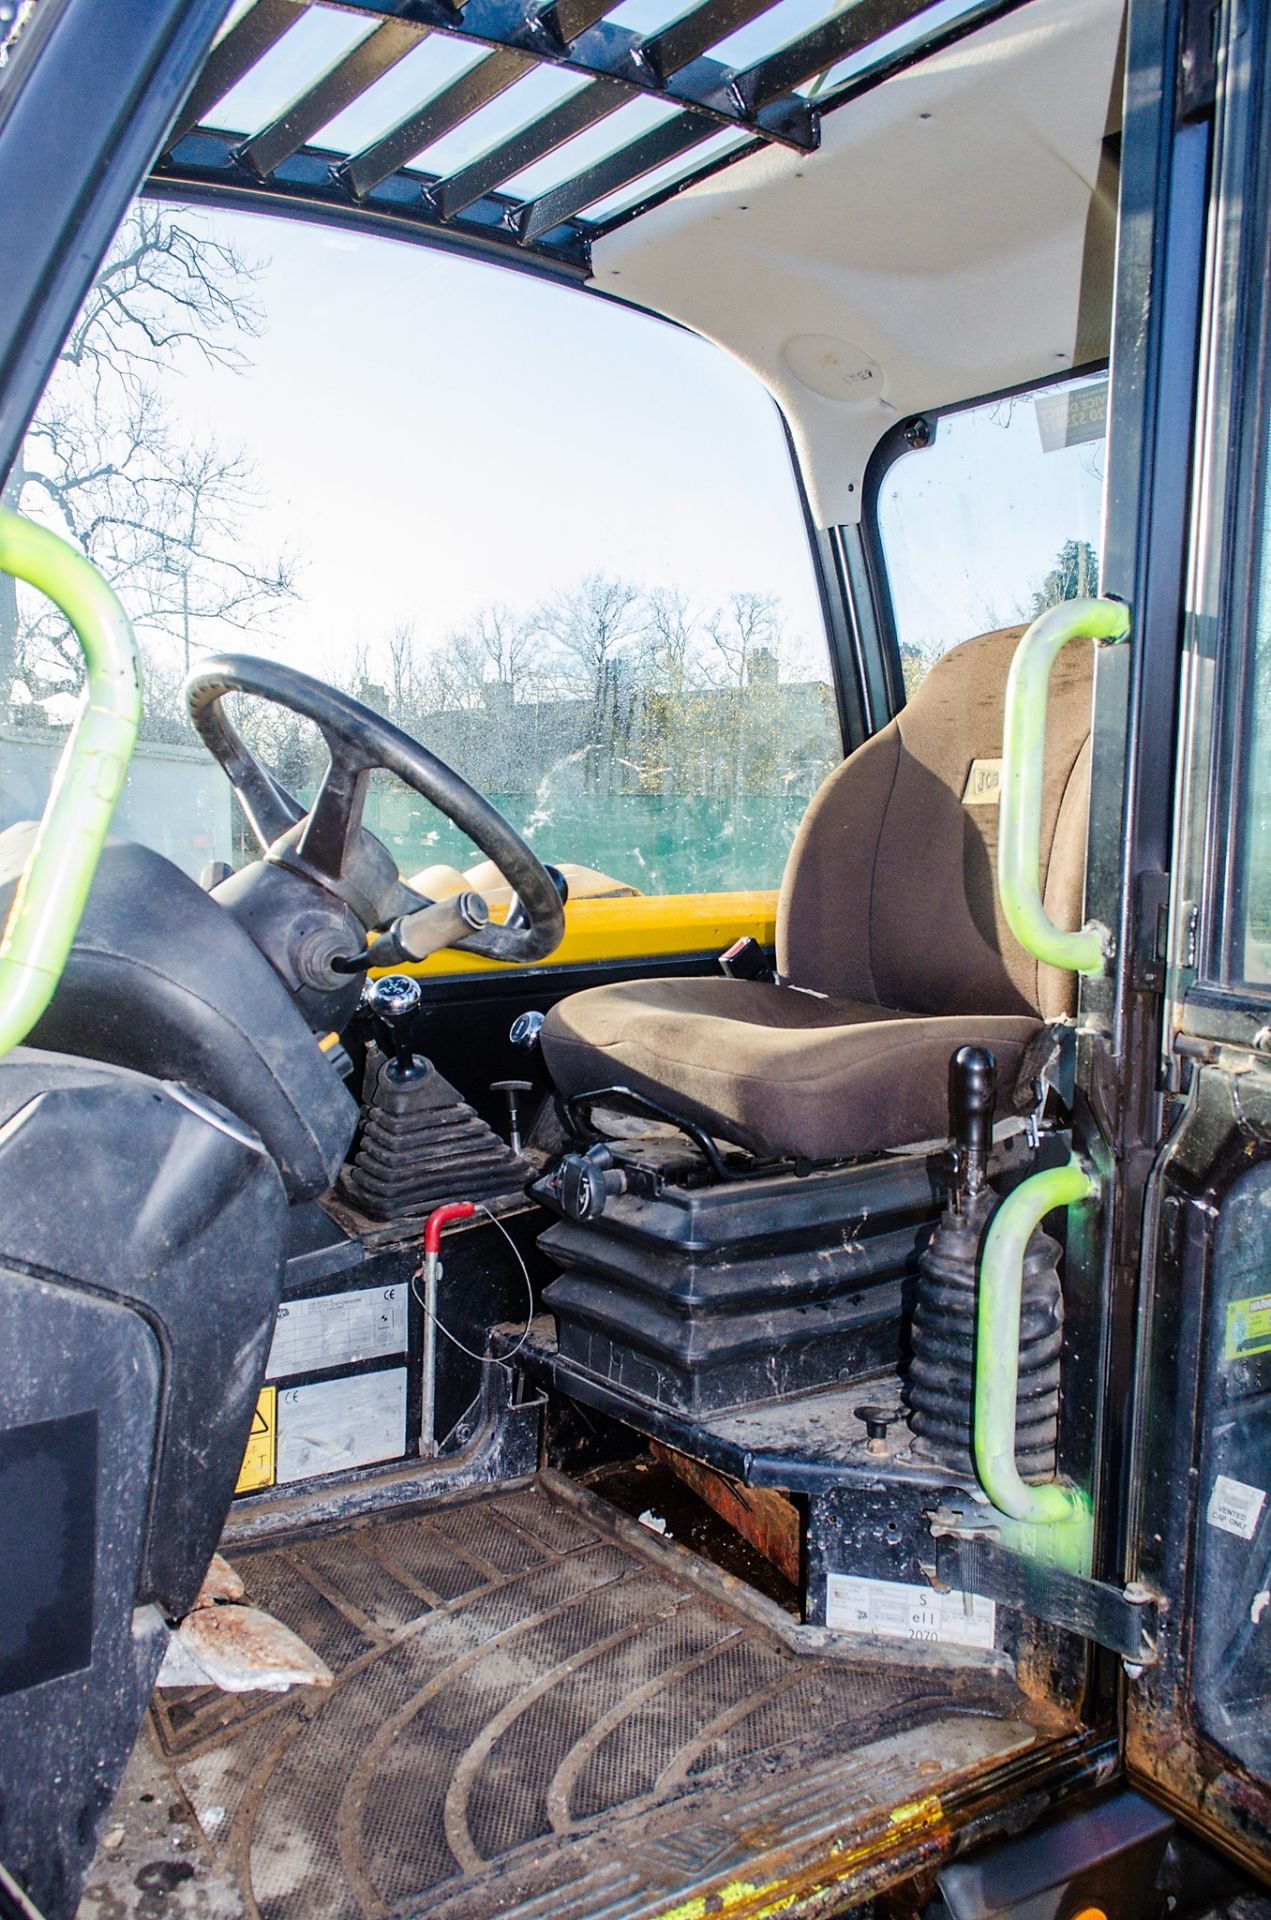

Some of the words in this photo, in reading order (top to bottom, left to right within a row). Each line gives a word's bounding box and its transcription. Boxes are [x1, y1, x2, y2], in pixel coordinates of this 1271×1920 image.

[1212, 1512, 1227, 1522] CAP
[1229, 1518, 1246, 1529] ONLY
[1218, 1505, 1247, 1521] VENTED
